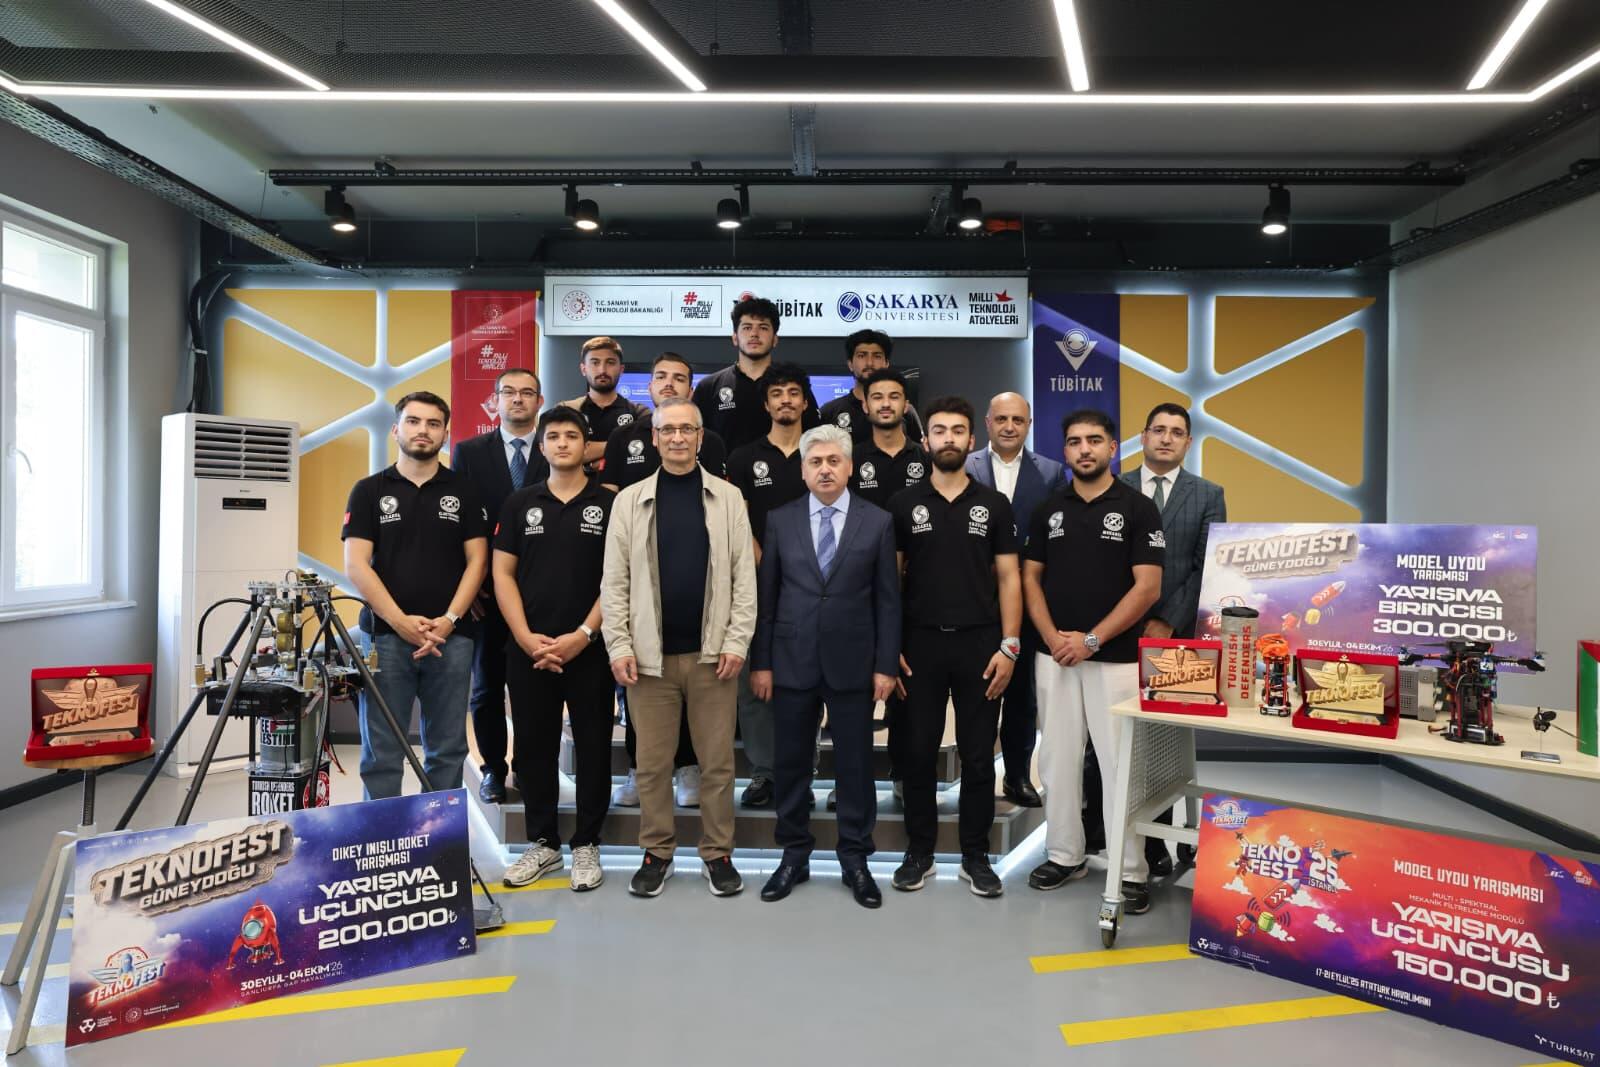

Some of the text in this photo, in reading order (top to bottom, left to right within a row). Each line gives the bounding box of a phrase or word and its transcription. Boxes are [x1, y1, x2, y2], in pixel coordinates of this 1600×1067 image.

[777, 300, 823, 318] ÜBİTAK
[865, 294, 958, 309] SAKARYA
[865, 309, 959, 321] ÜNİVERSİTESİ
[1050, 375, 1103, 392] TÜBİTAK
[1217, 530, 1355, 565] TEKNOFEST
[1243, 554, 1326, 574] GÜNEYDOĞU
[1396, 554, 1486, 571] MODEL UYDU
[1412, 569, 1469, 582] YARIŞMASI
[1378, 584, 1503, 604] YARIŞMA
[1227, 632, 1238, 689] TURKISH
[1240, 624, 1252, 700] DEFENDERS
[1148, 664, 1217, 689] TEKNOFEST
[1305, 681, 1385, 705] TEKNOFEST
[41, 693, 140, 731] TEKNOFEST
[398, 833, 430, 851] ROKET
[99, 823, 288, 904] TEKNOFEST
[355, 851, 411, 872] YARIŞMASI
[1240, 843, 1301, 864] TEKNO
[1248, 859, 1298, 880] FEST
[139, 862, 257, 910] GÜNEYDOĞU
[318, 865, 441, 900] YARIŞMA
[1394, 859, 1544, 904] MODEL UYDU YARIŞMASI
[1459, 897, 1500, 912] SPEKTRAL
[1391, 901, 1544, 954] YARIŞMA
[89, 962, 166, 1003] TEKNOFEST
[289, 969, 304, 980] 04
